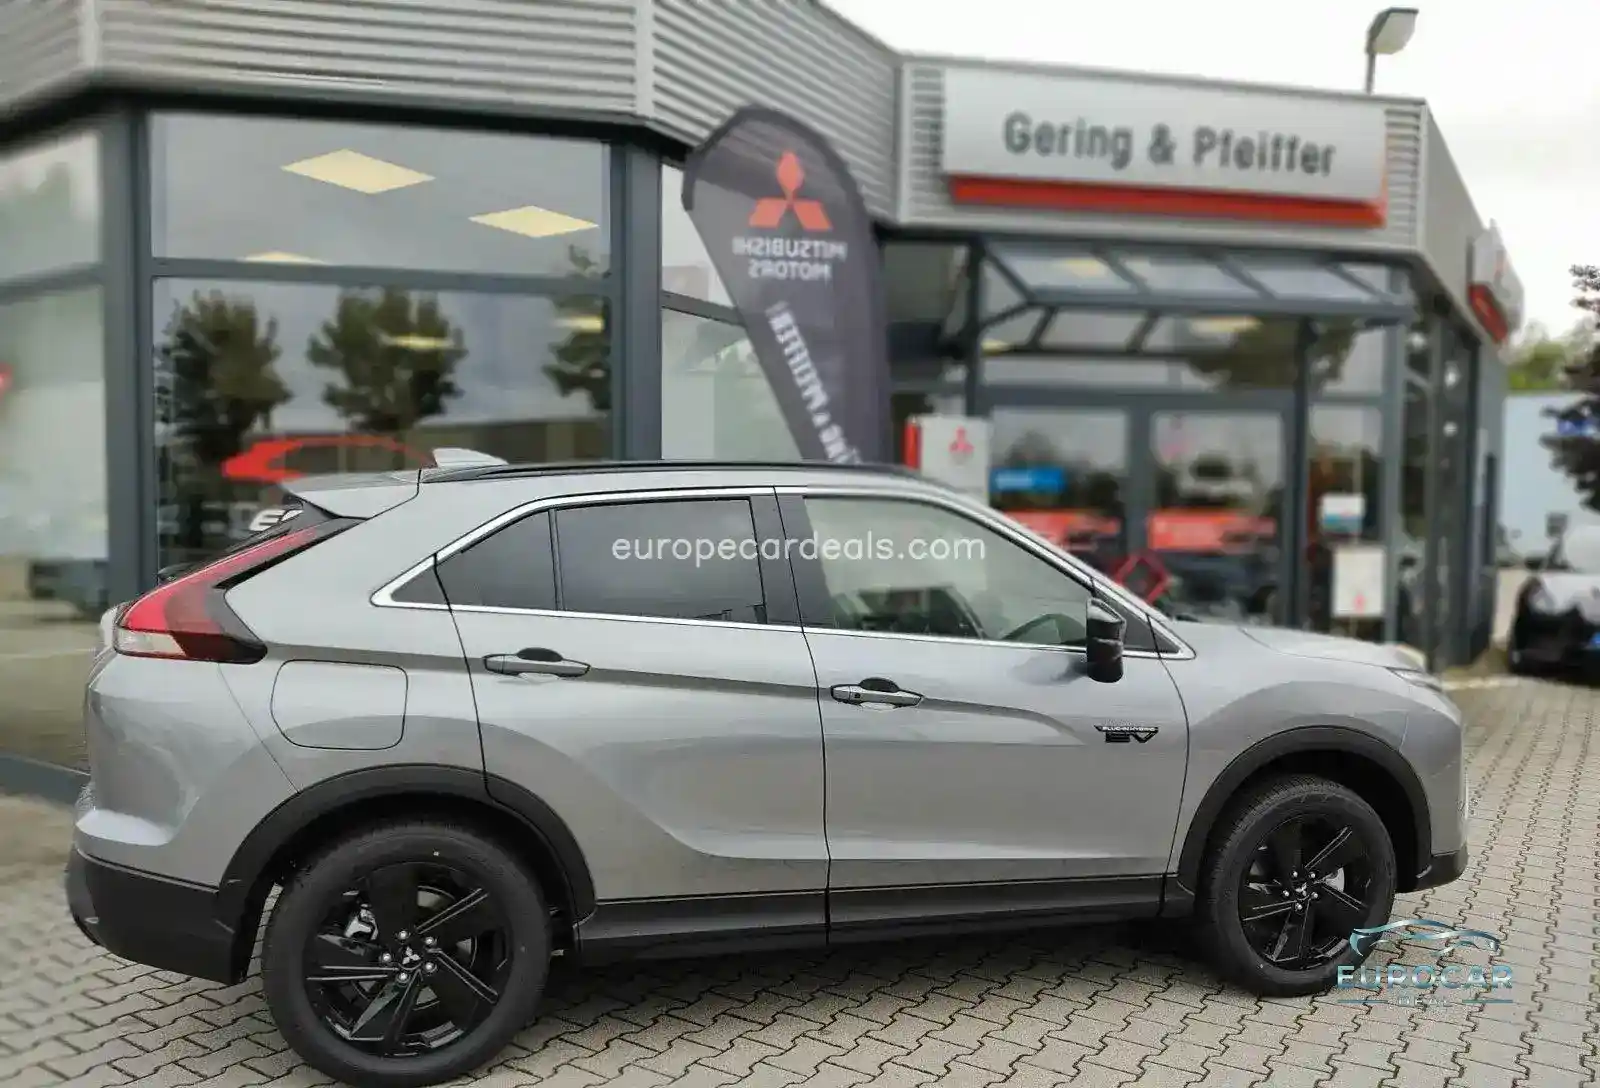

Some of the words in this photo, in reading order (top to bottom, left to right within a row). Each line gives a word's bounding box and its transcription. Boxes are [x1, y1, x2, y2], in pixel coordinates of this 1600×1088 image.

[1003, 111, 1133, 171] Gering
[1148, 123, 1177, 166] &
[1192, 125, 1336, 177] Pfeiffer
[1105, 731, 1157, 744] EV
